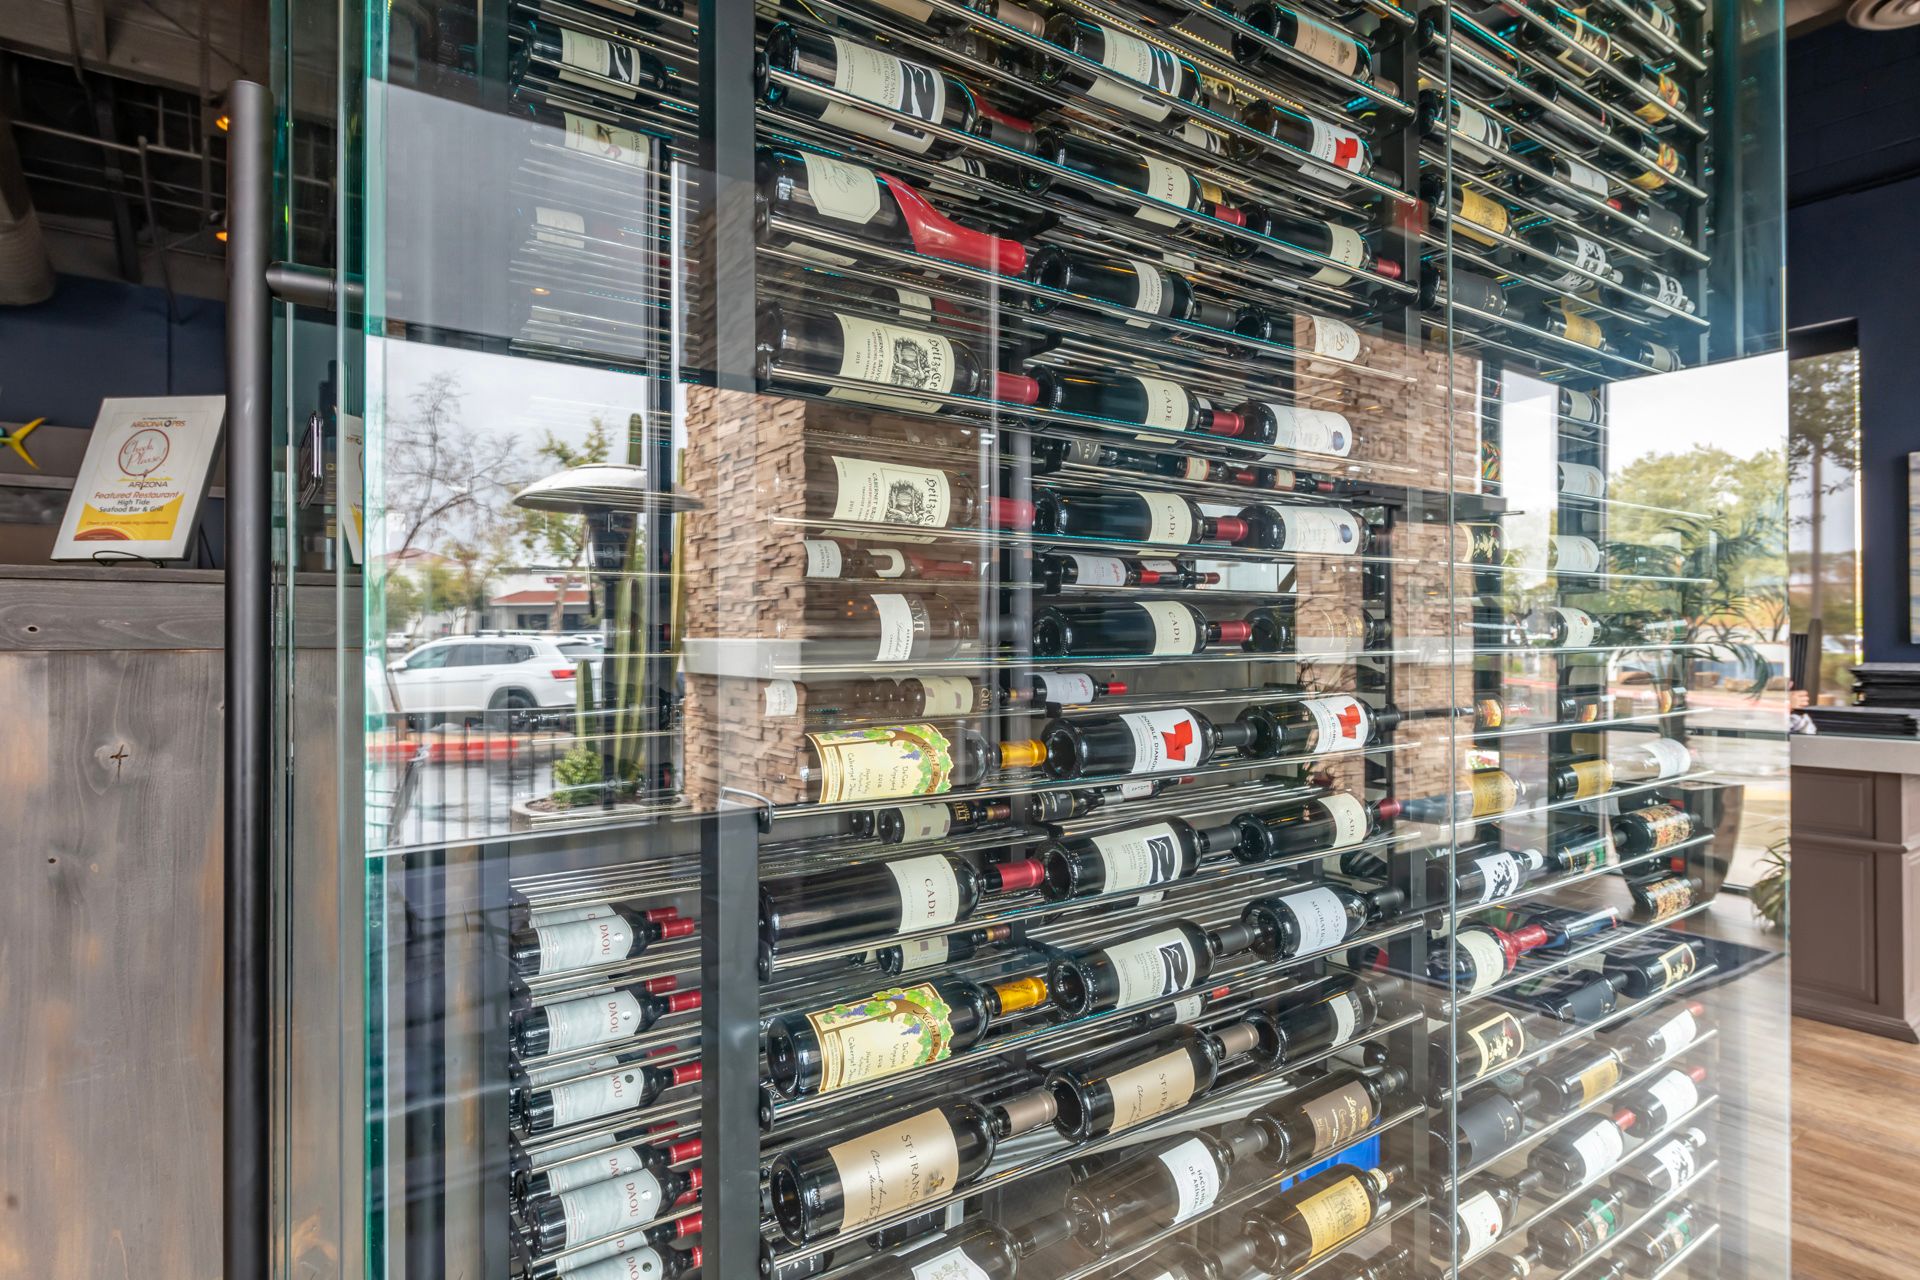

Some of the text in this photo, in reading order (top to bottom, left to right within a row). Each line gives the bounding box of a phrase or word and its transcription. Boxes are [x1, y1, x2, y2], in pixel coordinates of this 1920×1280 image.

[1165, 167, 1174, 200] CADE
[1343, 239, 1351, 263] CAD
[1163, 389, 1172, 421] CADE
[94, 490, 179, 499] Featured Restaurant
[1168, 505, 1176, 538] CADE
[1168, 611, 1180, 644] CADE
[924, 878, 936, 919] CADE
[600, 924, 611, 955] DAOU
[608, 1001, 619, 1033] DAOU
[626, 1182, 640, 1217] DAOU
[626, 1256, 640, 1280] DAO
